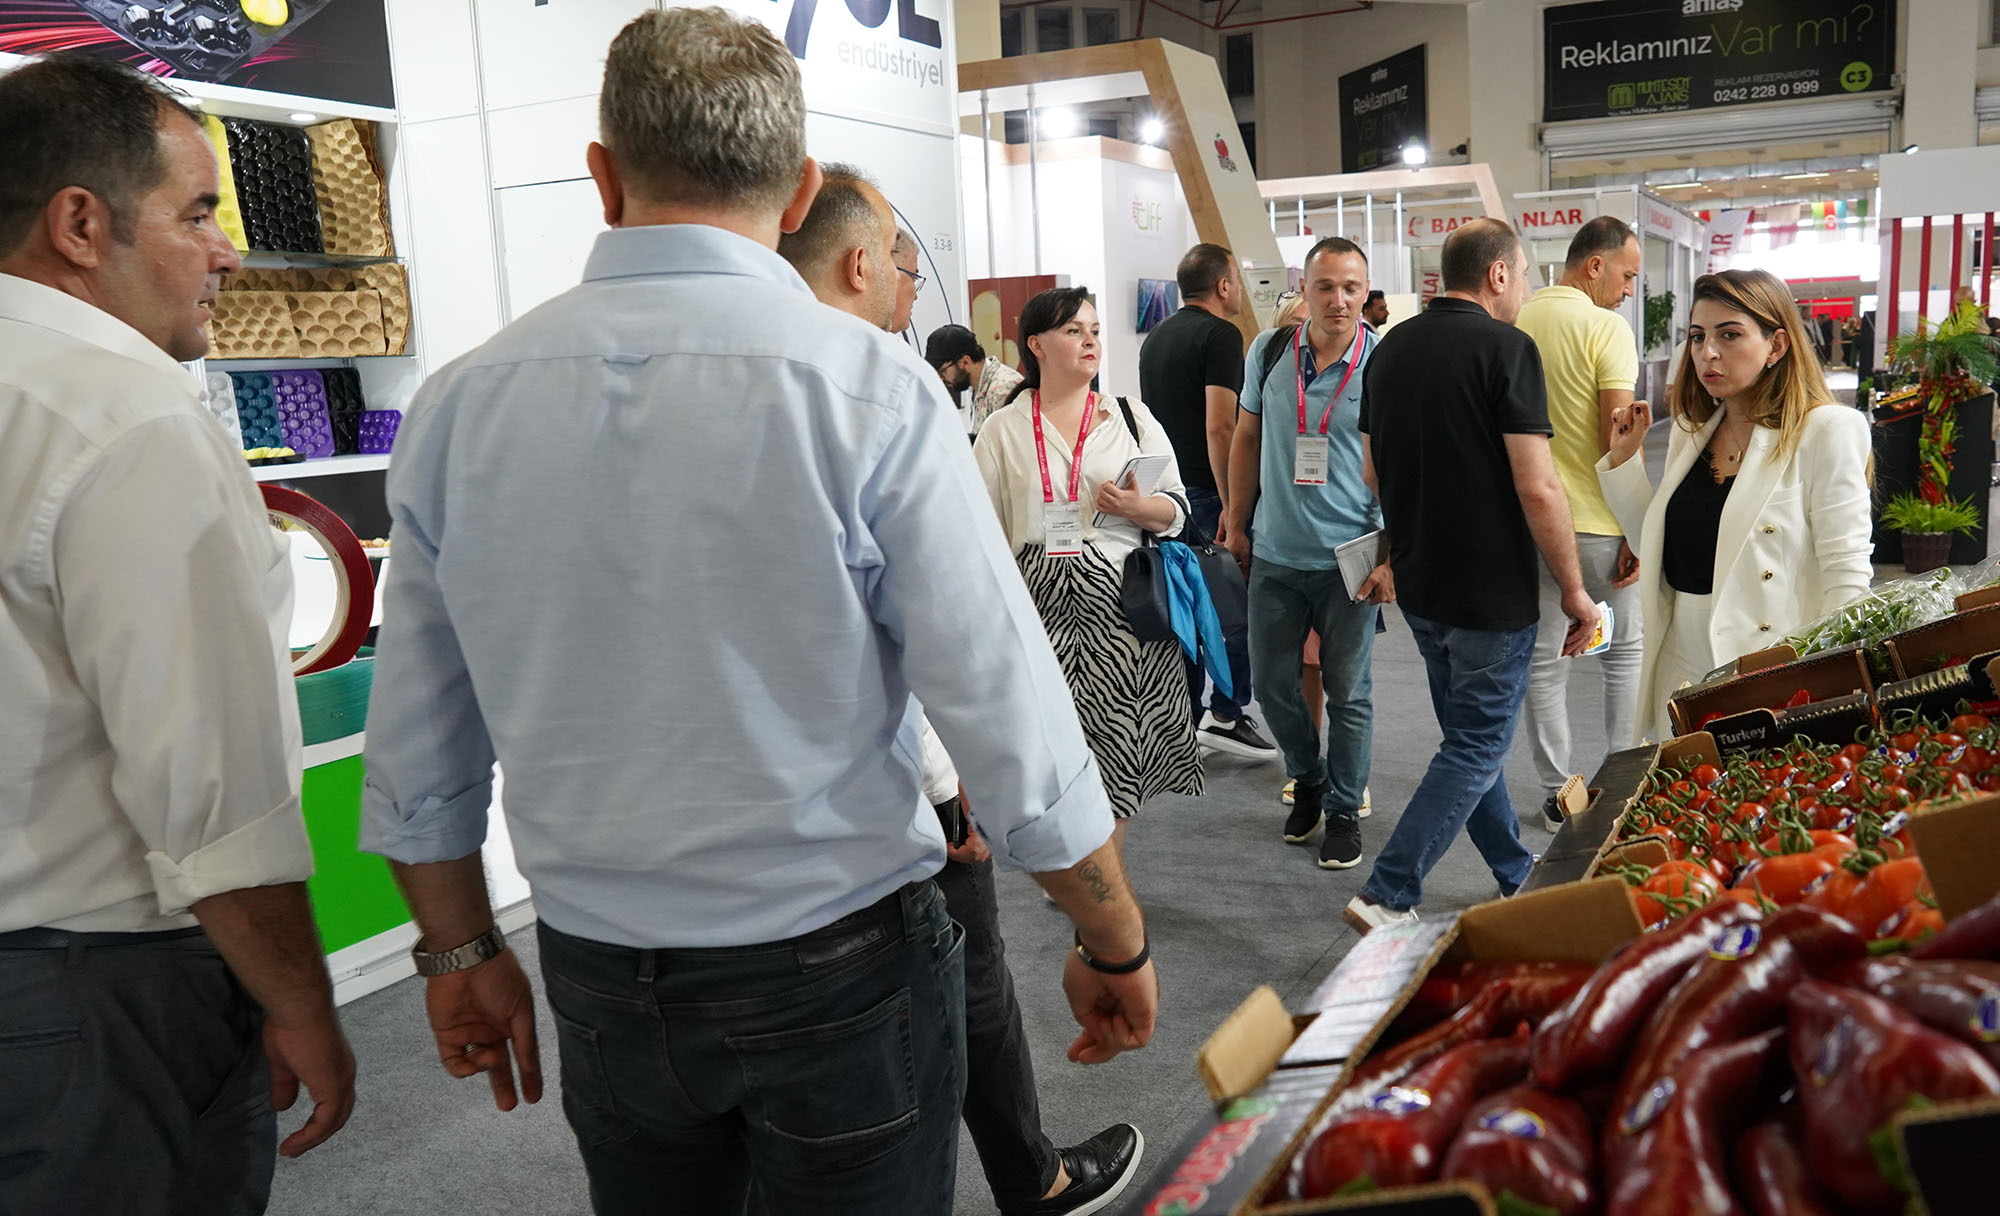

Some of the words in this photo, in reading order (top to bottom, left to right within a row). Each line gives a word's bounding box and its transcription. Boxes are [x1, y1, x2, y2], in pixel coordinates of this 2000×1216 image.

[1561, 35, 1713, 69] Reklamınız
[1711, 20, 1783, 57] Var
[838, 40, 944, 89] endüstriyel
[1846, 69, 1868, 84] C3
[1714, 87, 1748, 102] 0242
[1751, 84, 1777, 98] 228
[1780, 83, 1790, 96] 0
[1792, 79, 1820, 94] 999
[1718, 726, 1767, 745] Turkey
